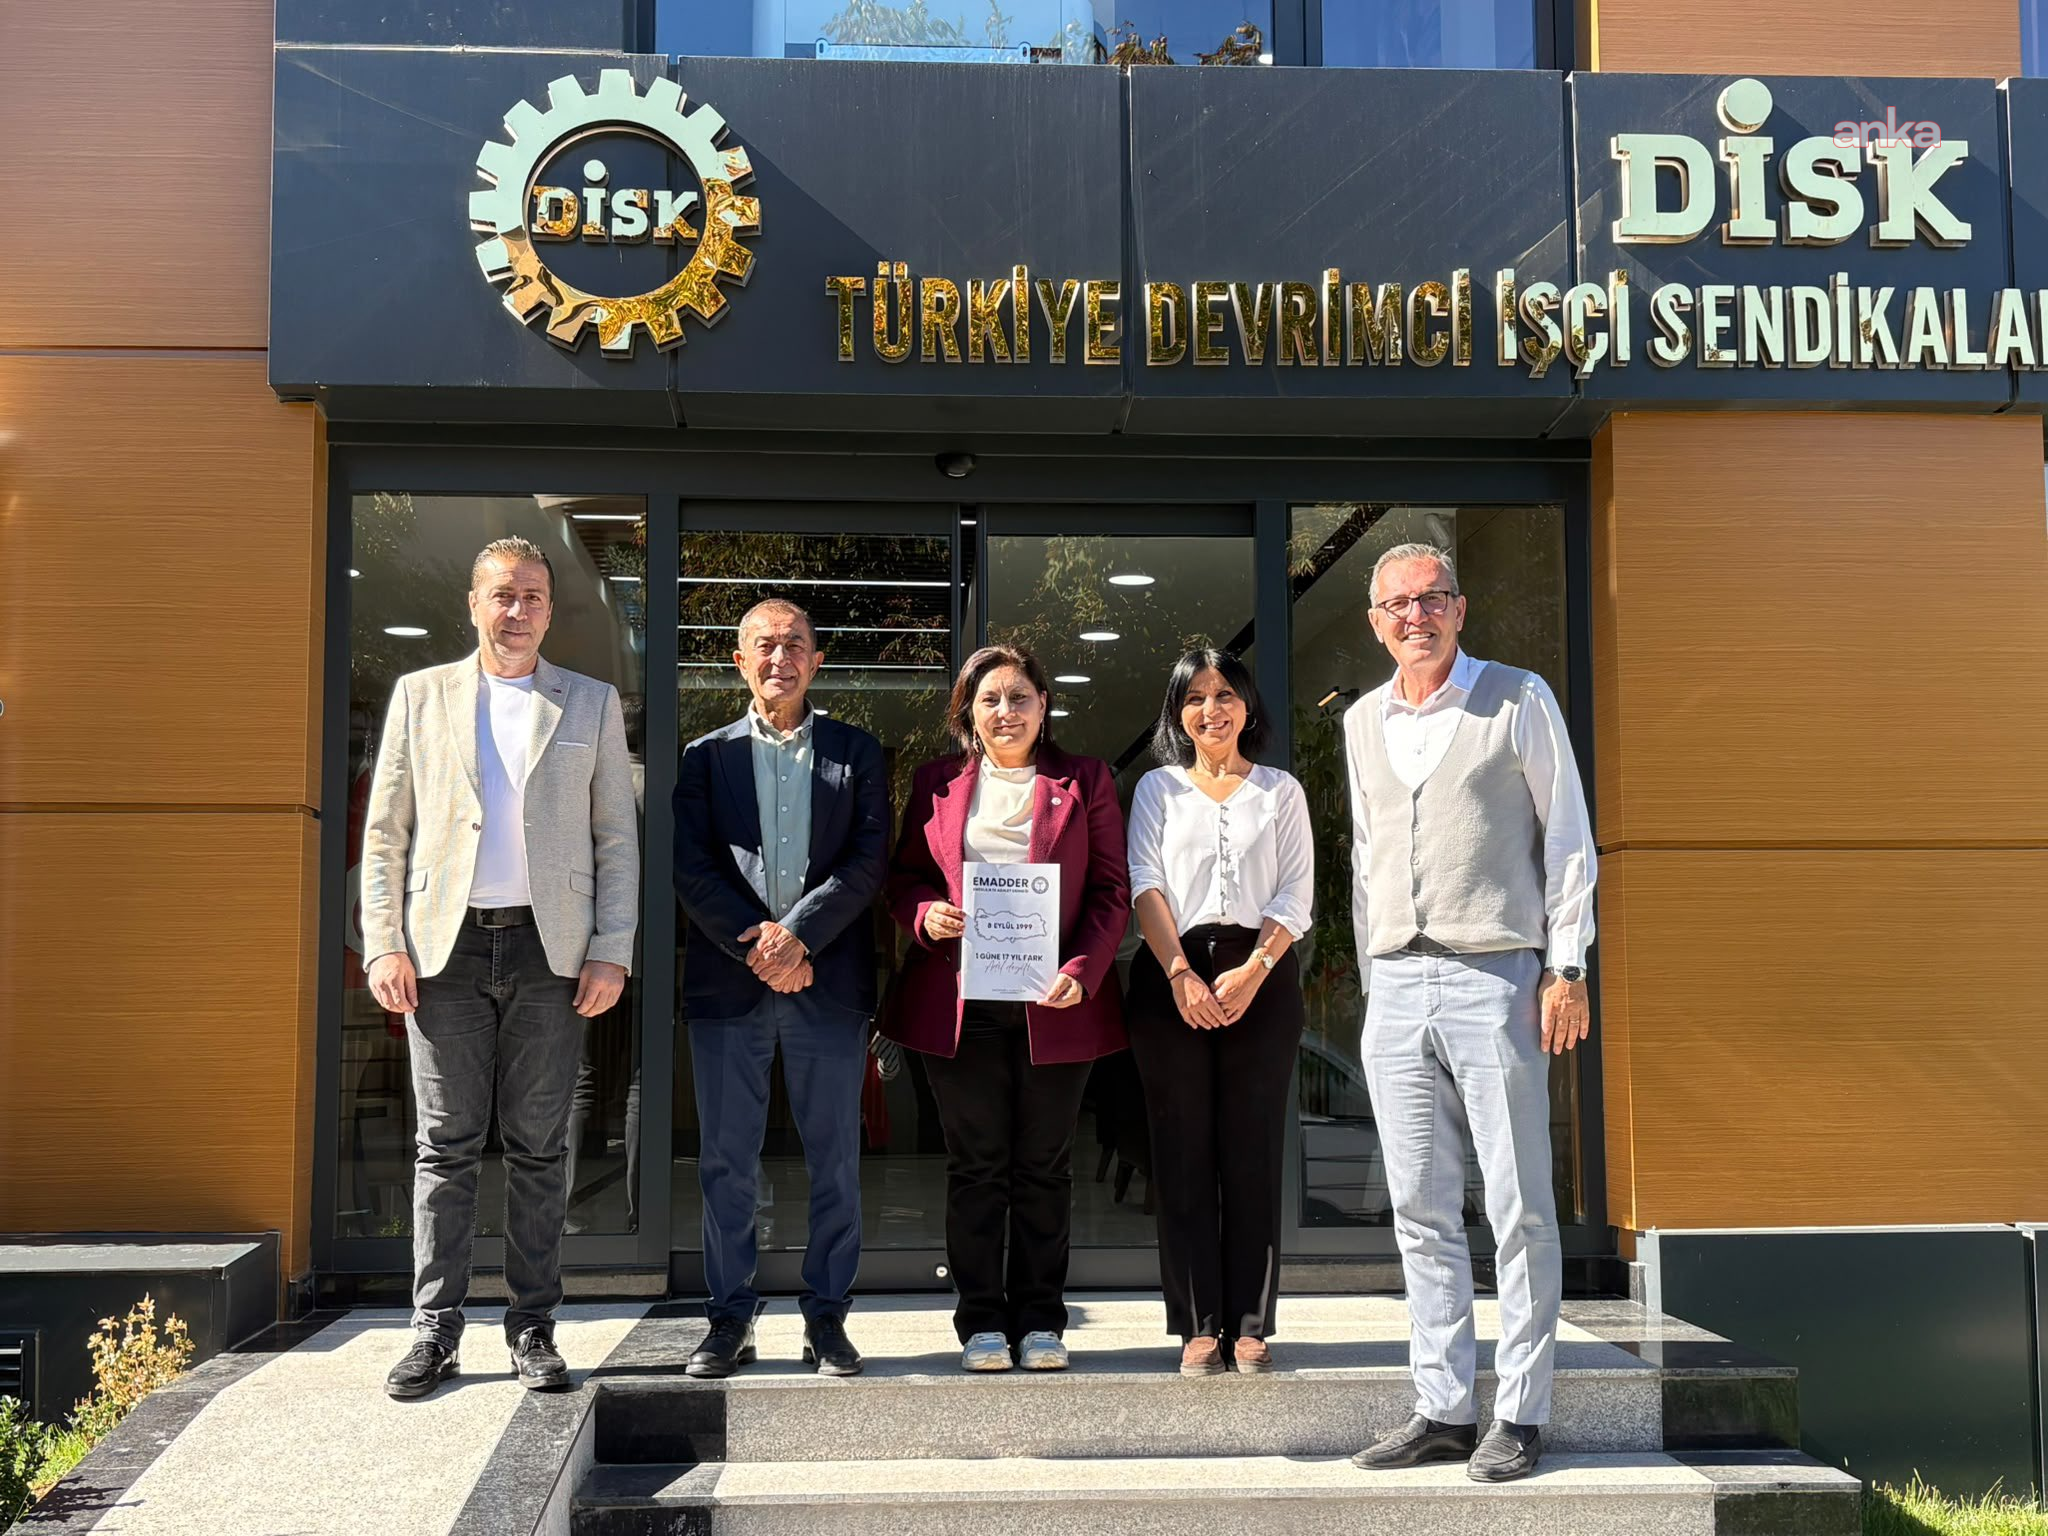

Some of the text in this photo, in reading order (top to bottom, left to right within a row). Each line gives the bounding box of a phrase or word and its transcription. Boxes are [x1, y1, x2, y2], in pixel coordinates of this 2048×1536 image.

[826, 260, 1121, 365] TÜRKİYE
[1145, 267, 1472, 366] DEVRİMCİ
[1496, 268, 1631, 379] İŞÇİ
[973, 876, 1029, 888] EMADDER
[993, 921, 1014, 930] EYLÜL
[980, 951, 1001, 960] GÜNE
[1011, 953, 1022, 961] YIL
[1023, 954, 1043, 962] FARK
